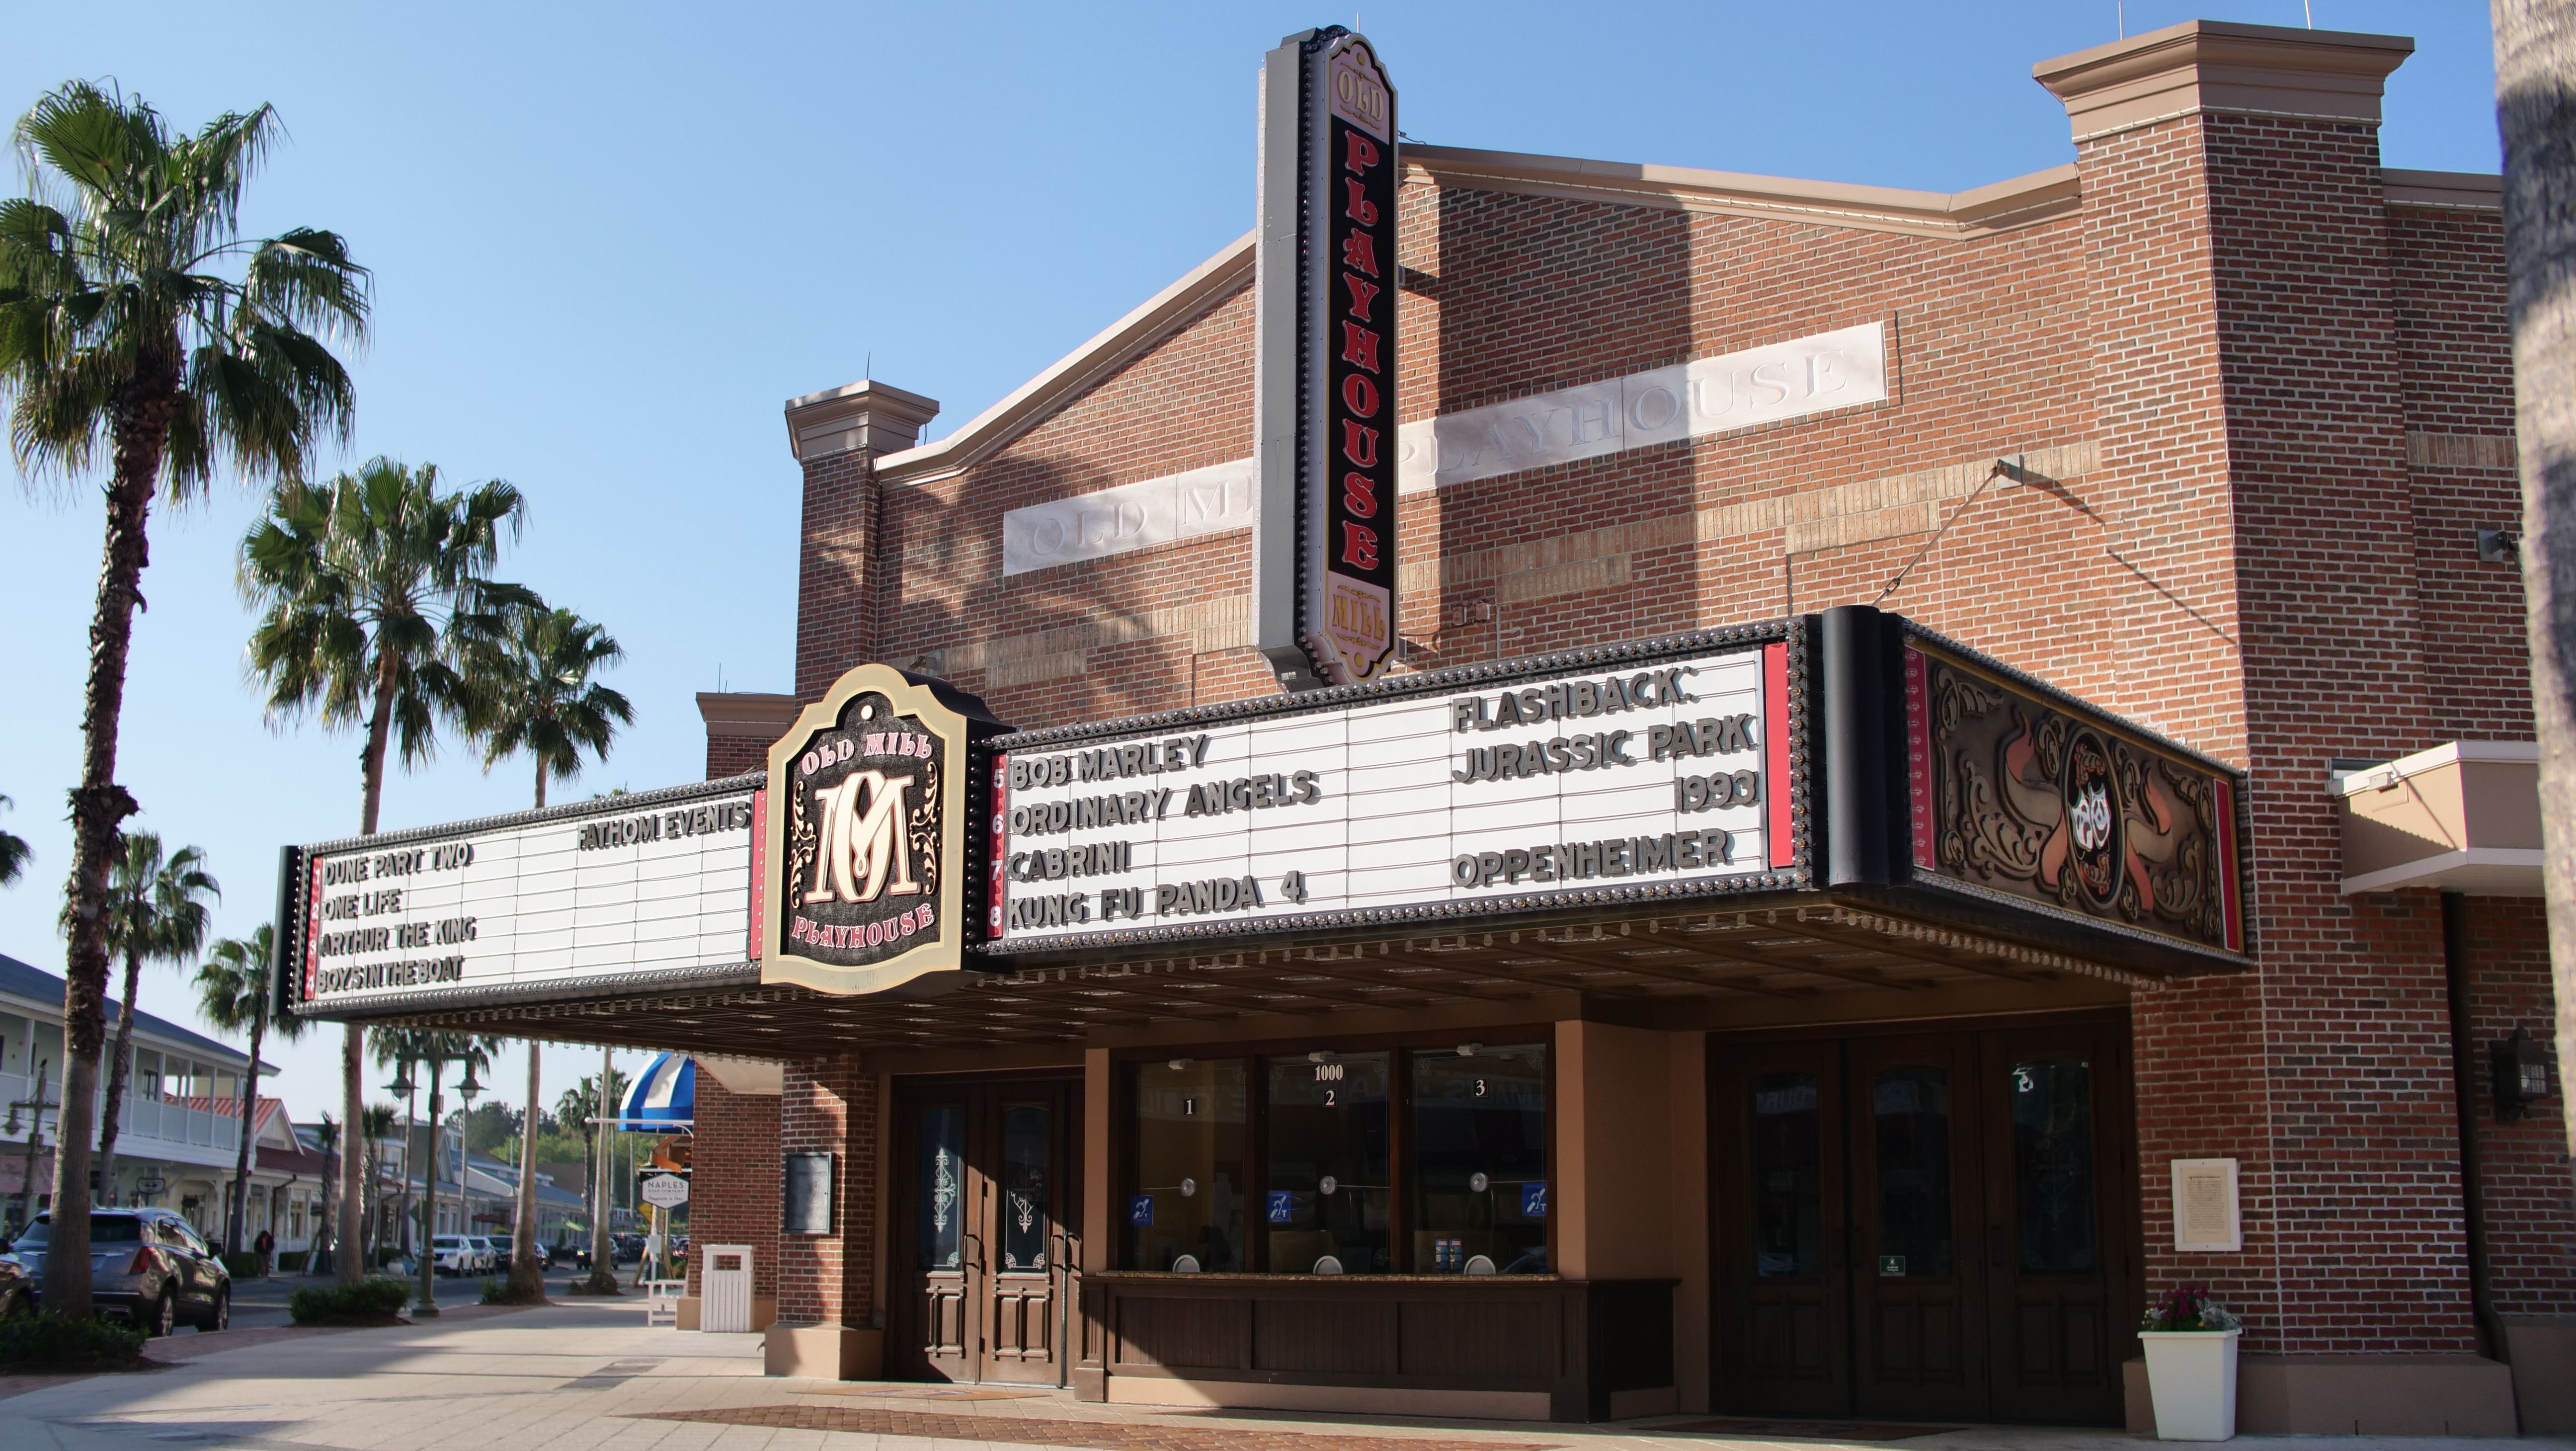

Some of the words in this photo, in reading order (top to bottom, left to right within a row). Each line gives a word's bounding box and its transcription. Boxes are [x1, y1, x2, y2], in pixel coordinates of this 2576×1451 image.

[1338, 71, 1384, 122] OLD
[1342, 129, 1380, 570] PLAYHOUSE
[1029, 501, 1149, 556] OLD
[1331, 594, 1386, 641] MILL
[803, 738, 855, 775] OLD
[864, 731, 933, 759] MILL
[1012, 755, 1070, 790] BOB
[1078, 733, 1207, 782] MARLEY
[1451, 729, 1630, 783] JURASSIC
[1647, 713, 1752, 760] PARK
[993, 769, 1005, 788] 5
[1675, 770, 1757, 813] 1993
[1011, 787, 1169, 835] ORDINARY
[1184, 770, 1315, 817] ANGELS
[578, 814, 657, 850] FATHOM
[664, 801, 752, 839] EVENTS
[992, 814, 1003, 834] 6
[315, 868, 321, 884] 1
[325, 857, 369, 885] DUNE
[374, 849, 424, 878] PART
[430, 842, 473, 871] TWO
[991, 860, 1003, 881] 7
[1008, 840, 1129, 882] CABRINI
[1451, 827, 1728, 887] OPPENHEIMER
[312, 903, 319, 919] 2
[324, 894, 358, 920] ONE
[363, 888, 402, 916] LIFE
[990, 906, 1001, 926] 8
[1008, 891, 1086, 929] KUNG
[1100, 887, 1139, 920] FU
[1156, 875, 1260, 916] PANDA
[1280, 870, 1302, 903] 4
[320, 927, 389, 957] ARTHUR
[395, 922, 429, 948] THE
[435, 916, 477, 945] KING
[792, 902, 936, 949] PLAYHOUSE
[307, 974, 314, 990] 4
[1315, 1064, 1343, 1081] 1000
[1475, 1079, 1485, 1096] 3
[1186, 1099, 1193, 1115] 1
[1325, 1090, 1335, 1106] 2
[647, 1181, 684, 1189] NAPLES
